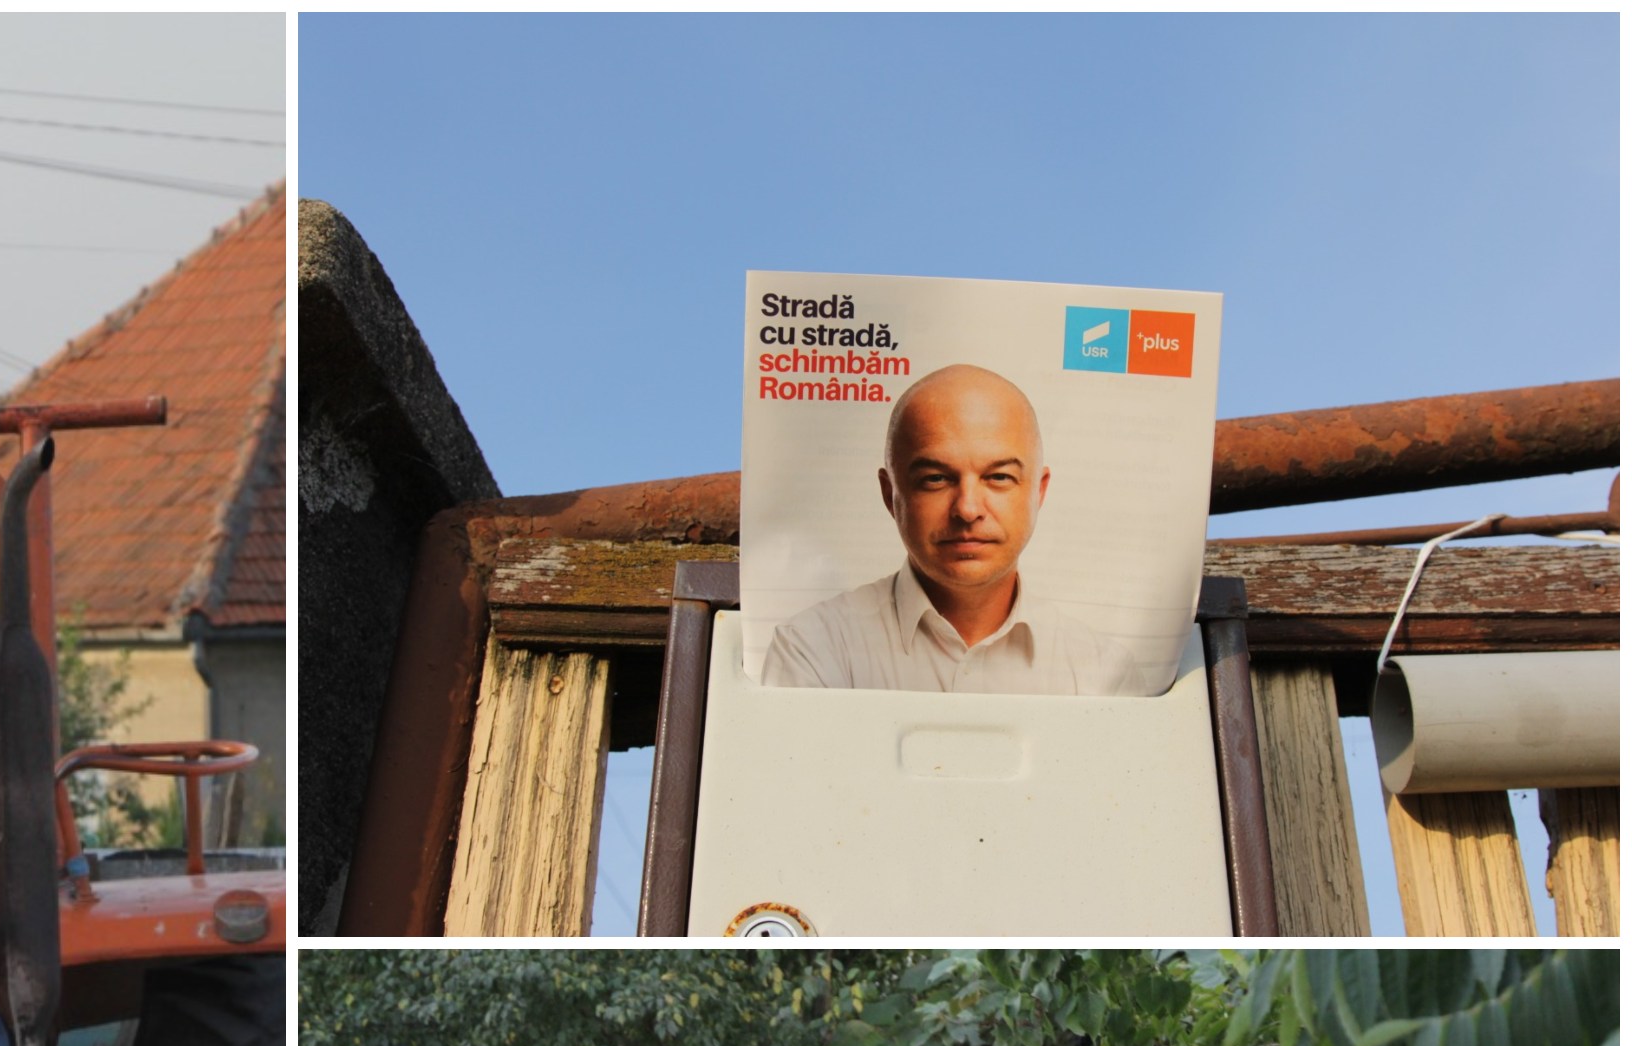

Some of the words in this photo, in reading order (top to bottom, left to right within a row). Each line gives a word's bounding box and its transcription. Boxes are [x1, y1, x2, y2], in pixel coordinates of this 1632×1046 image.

[761, 293, 854, 319] Stradă
[759, 325, 795, 345] cu
[801, 323, 899, 351] stradă,
[759, 348, 910, 375] schimbăm
[1082, 346, 1109, 358] USR
[759, 376, 891, 402] România.
